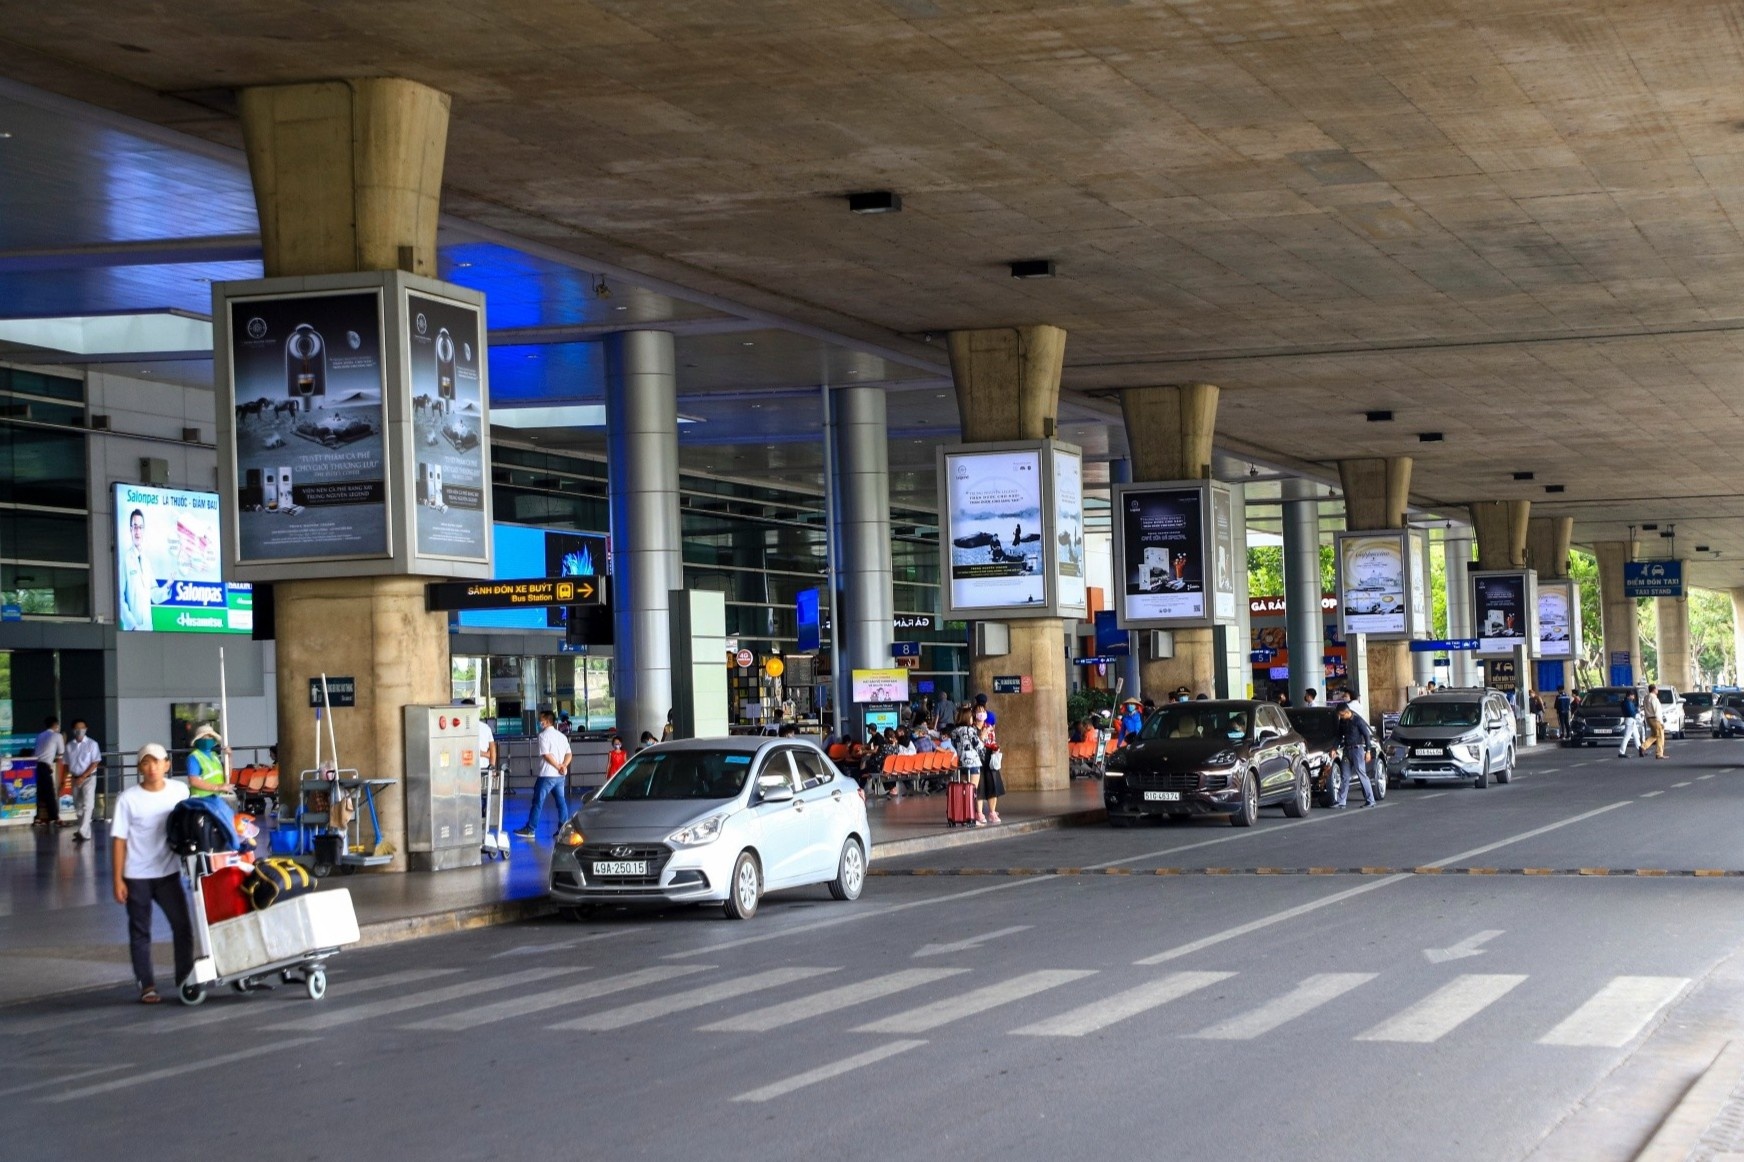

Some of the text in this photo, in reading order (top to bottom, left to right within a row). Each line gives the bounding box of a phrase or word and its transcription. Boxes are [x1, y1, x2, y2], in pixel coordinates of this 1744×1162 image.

[127, 489, 158, 506] Salonpas
[468, 583, 552, 596] SẢNH ĐÓN XE BUÝT
[1251, 600, 1266, 611] GÀ
[903, 644, 910, 654] 8
[595, 862, 644, 874] 49A-250.15
